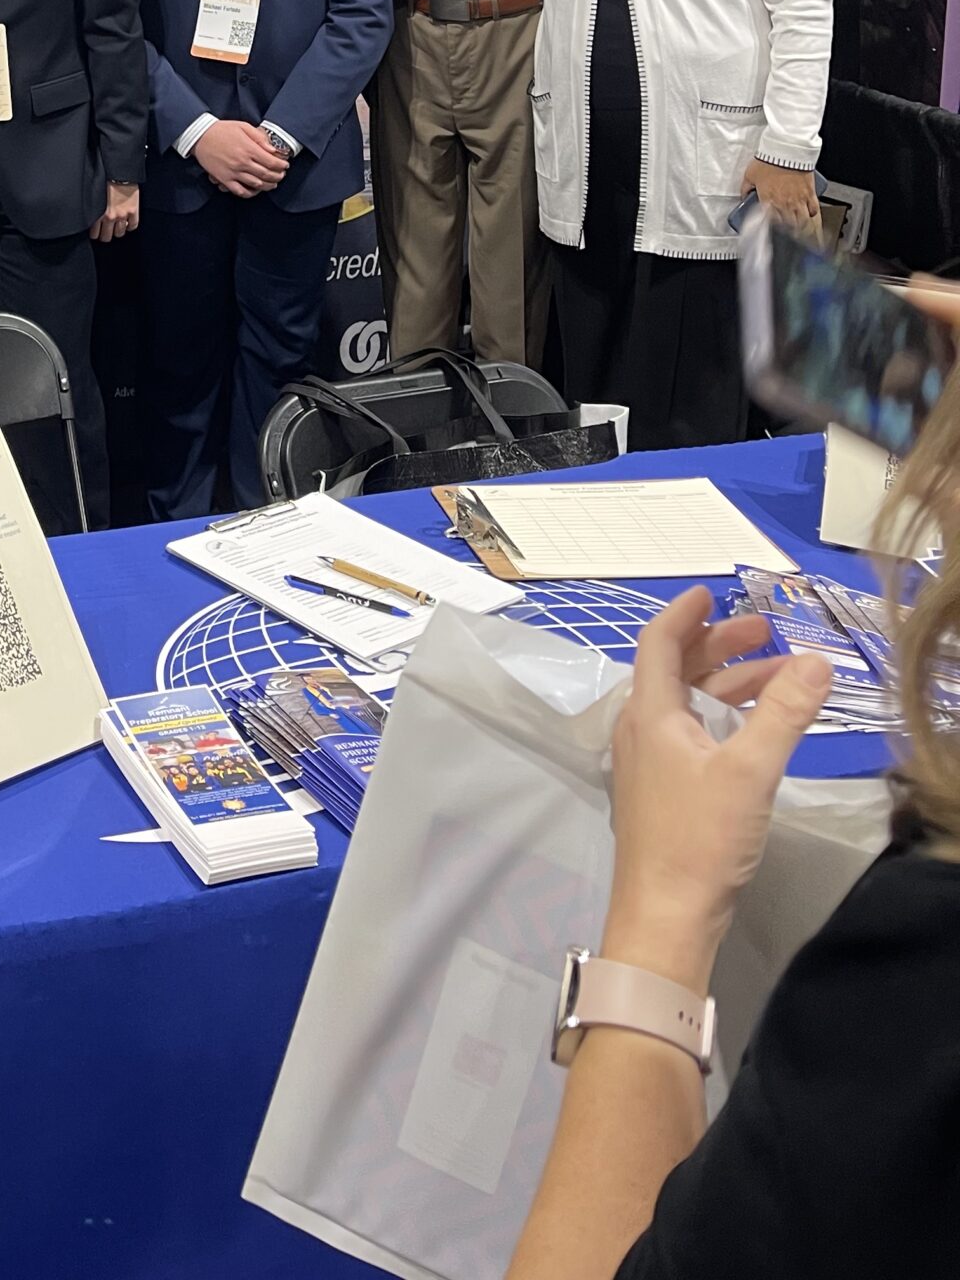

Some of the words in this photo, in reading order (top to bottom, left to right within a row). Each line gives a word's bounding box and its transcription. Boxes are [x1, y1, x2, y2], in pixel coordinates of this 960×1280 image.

[129, 712, 183, 726] Preparatory
[186, 707, 218, 717] School
[148, 706, 190, 718] Remnant
